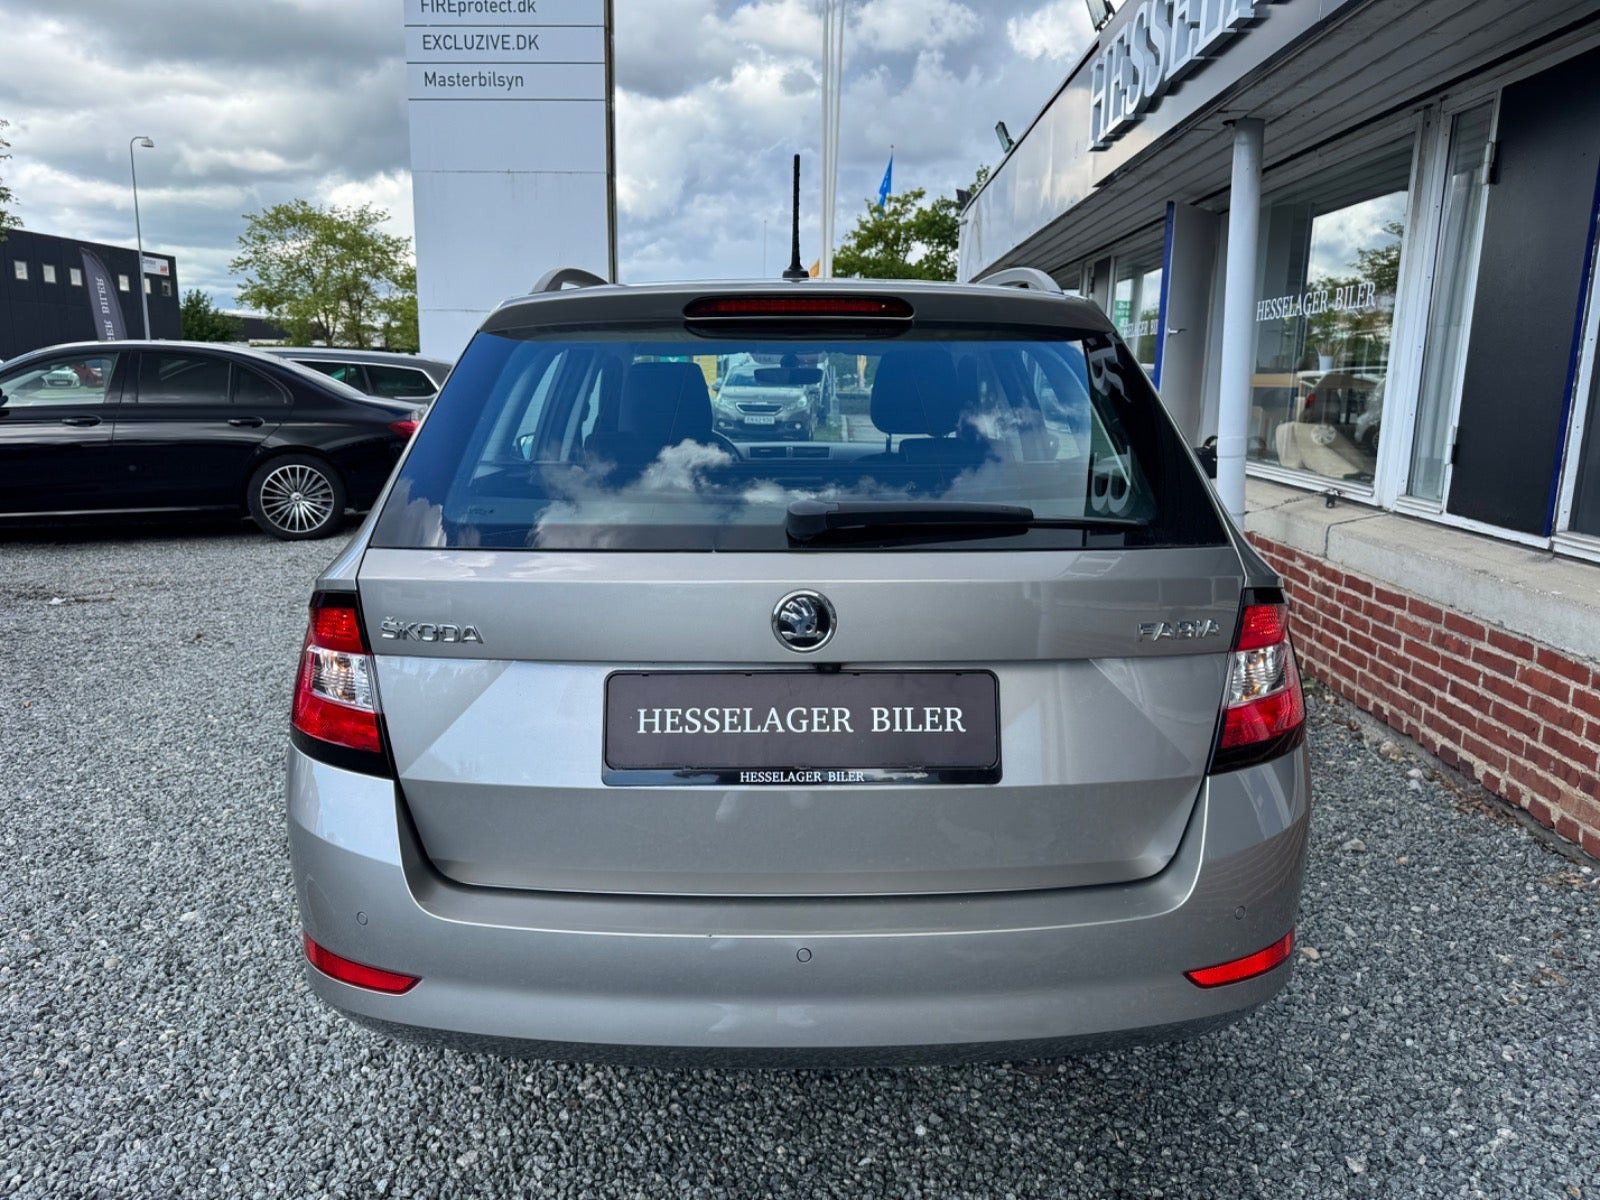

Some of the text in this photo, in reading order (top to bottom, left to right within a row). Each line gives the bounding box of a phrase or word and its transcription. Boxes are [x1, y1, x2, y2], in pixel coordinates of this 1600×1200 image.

[421, 0, 537, 17] FIREprotect.dk
[422, 34, 540, 51] EXCLUZIVE.DK
[424, 71, 524, 91] Masterbilsyn
[1089, 0, 1255, 151] HESSEL
[1256, 281, 1376, 322] HESSELAGER BILER
[381, 616, 484, 644] ŠKODA
[1136, 619, 1220, 641] FABIA
[637, 707, 966, 734] HESSELAGER BILER
[740, 771, 865, 783] HESSELAGER BILER
